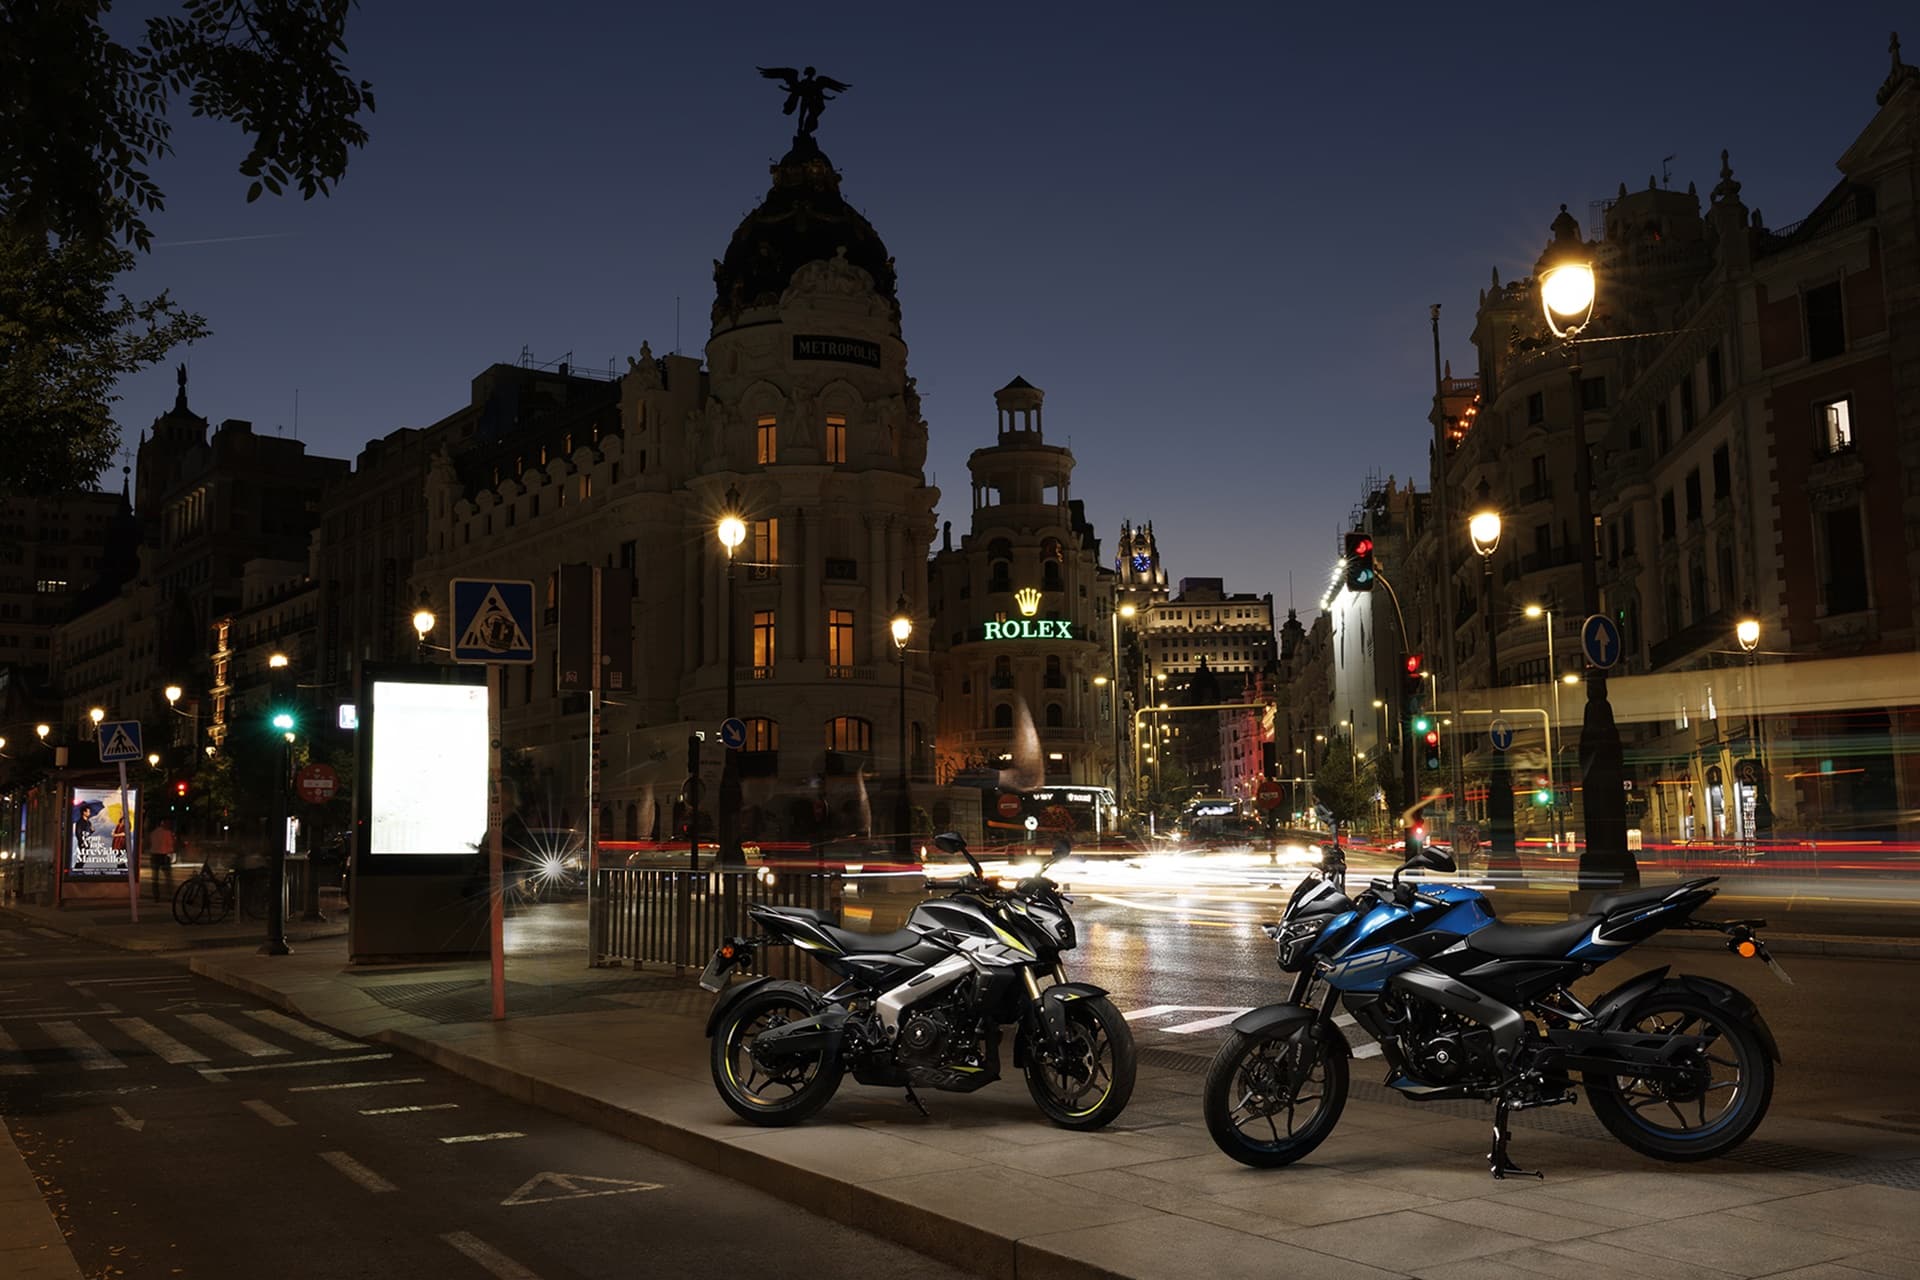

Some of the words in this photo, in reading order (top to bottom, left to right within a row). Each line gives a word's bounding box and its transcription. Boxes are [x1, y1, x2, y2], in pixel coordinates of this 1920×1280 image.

[799, 340, 879, 362] METROPOLIS
[984, 620, 1073, 640] ROLEX
[76, 847, 119, 856] Atrevido
[119, 849, 127, 858] y
[76, 854, 128, 863] Maravillos
